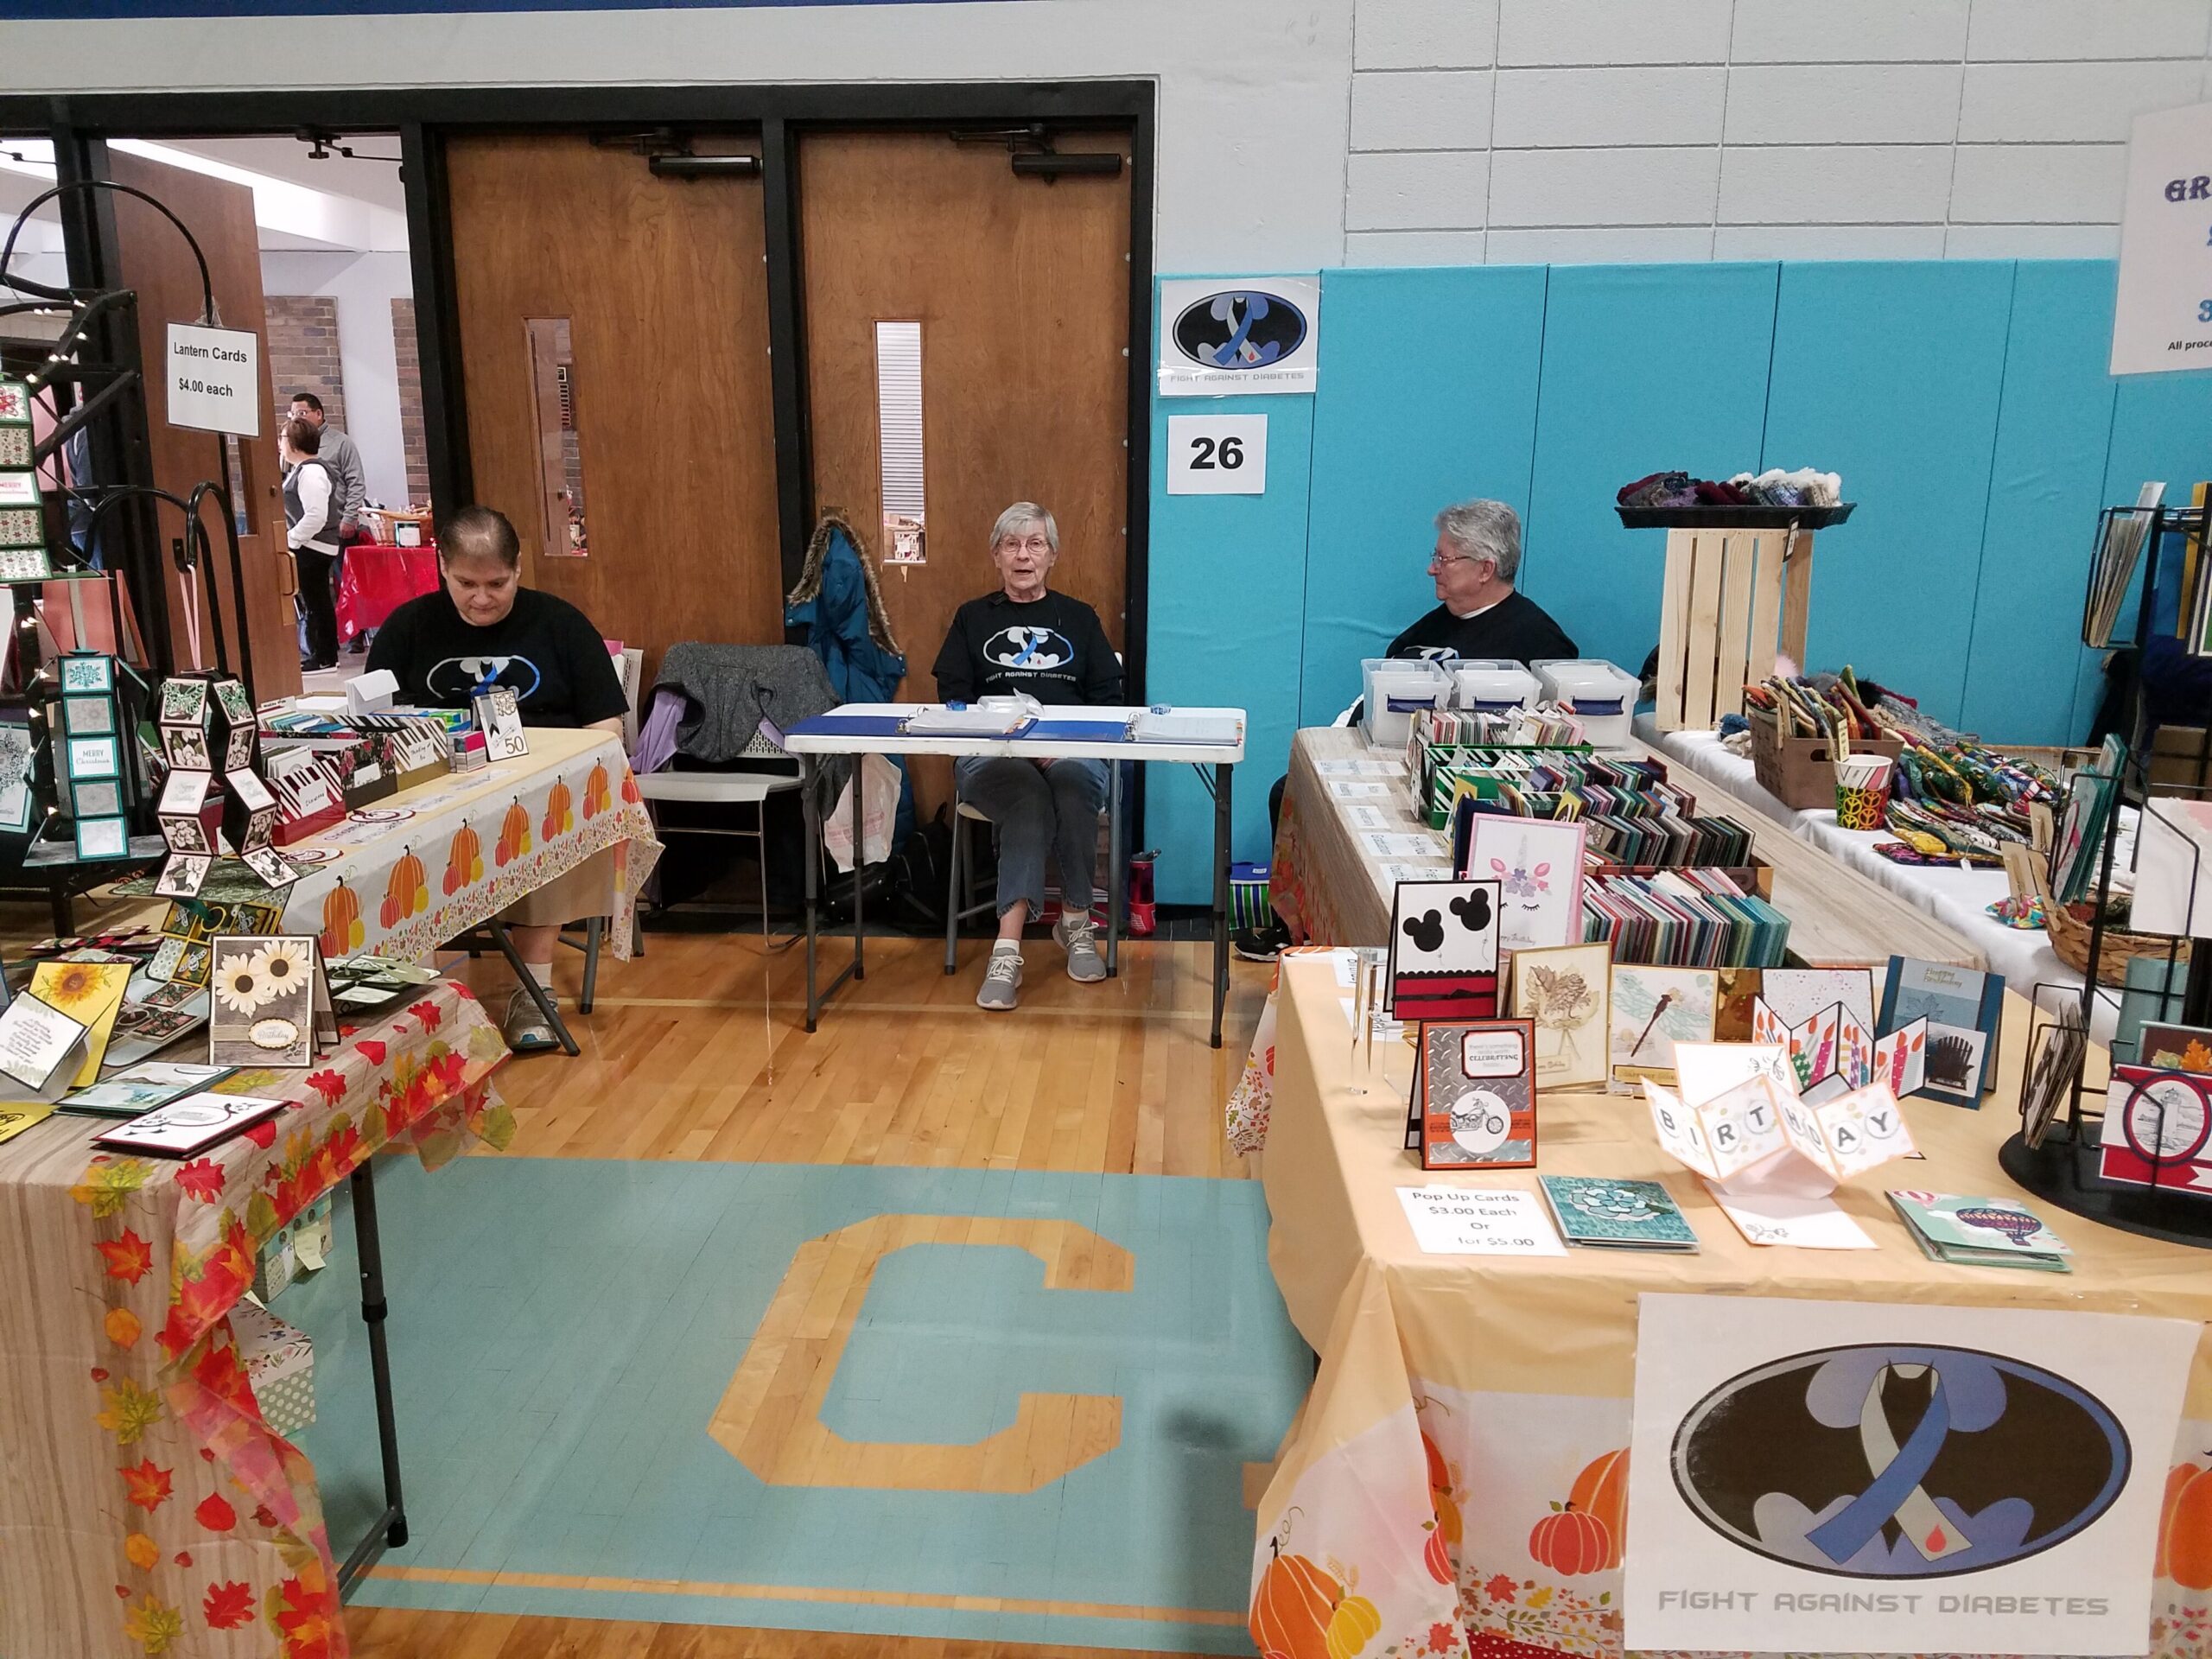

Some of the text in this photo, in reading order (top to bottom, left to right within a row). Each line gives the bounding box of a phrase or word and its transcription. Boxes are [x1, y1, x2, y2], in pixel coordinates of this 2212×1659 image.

[2168, 340, 2183, 351] All
[174, 341, 247, 363] Lantern Cards
[1171, 372, 1305, 383] FIGHT AGAINST DIABETES
[179, 377, 233, 397] $4.00 each
[1189, 436, 1244, 470] 26
[986, 672, 1002, 683] FIGHT
[1040, 672, 1077, 683] DIABETES
[505, 735, 524, 754] 50
[1413, 1192, 1443, 1202] Pop
[1447, 1193, 1470, 1203] Up
[1429, 1205, 1517, 1217] $3.00 Each
[1470, 1222, 1491, 1230] Or
[1487, 1236, 1535, 1247] $5.00
[1658, 1590, 2110, 1617] FIGHT AGAINST DIABETES
